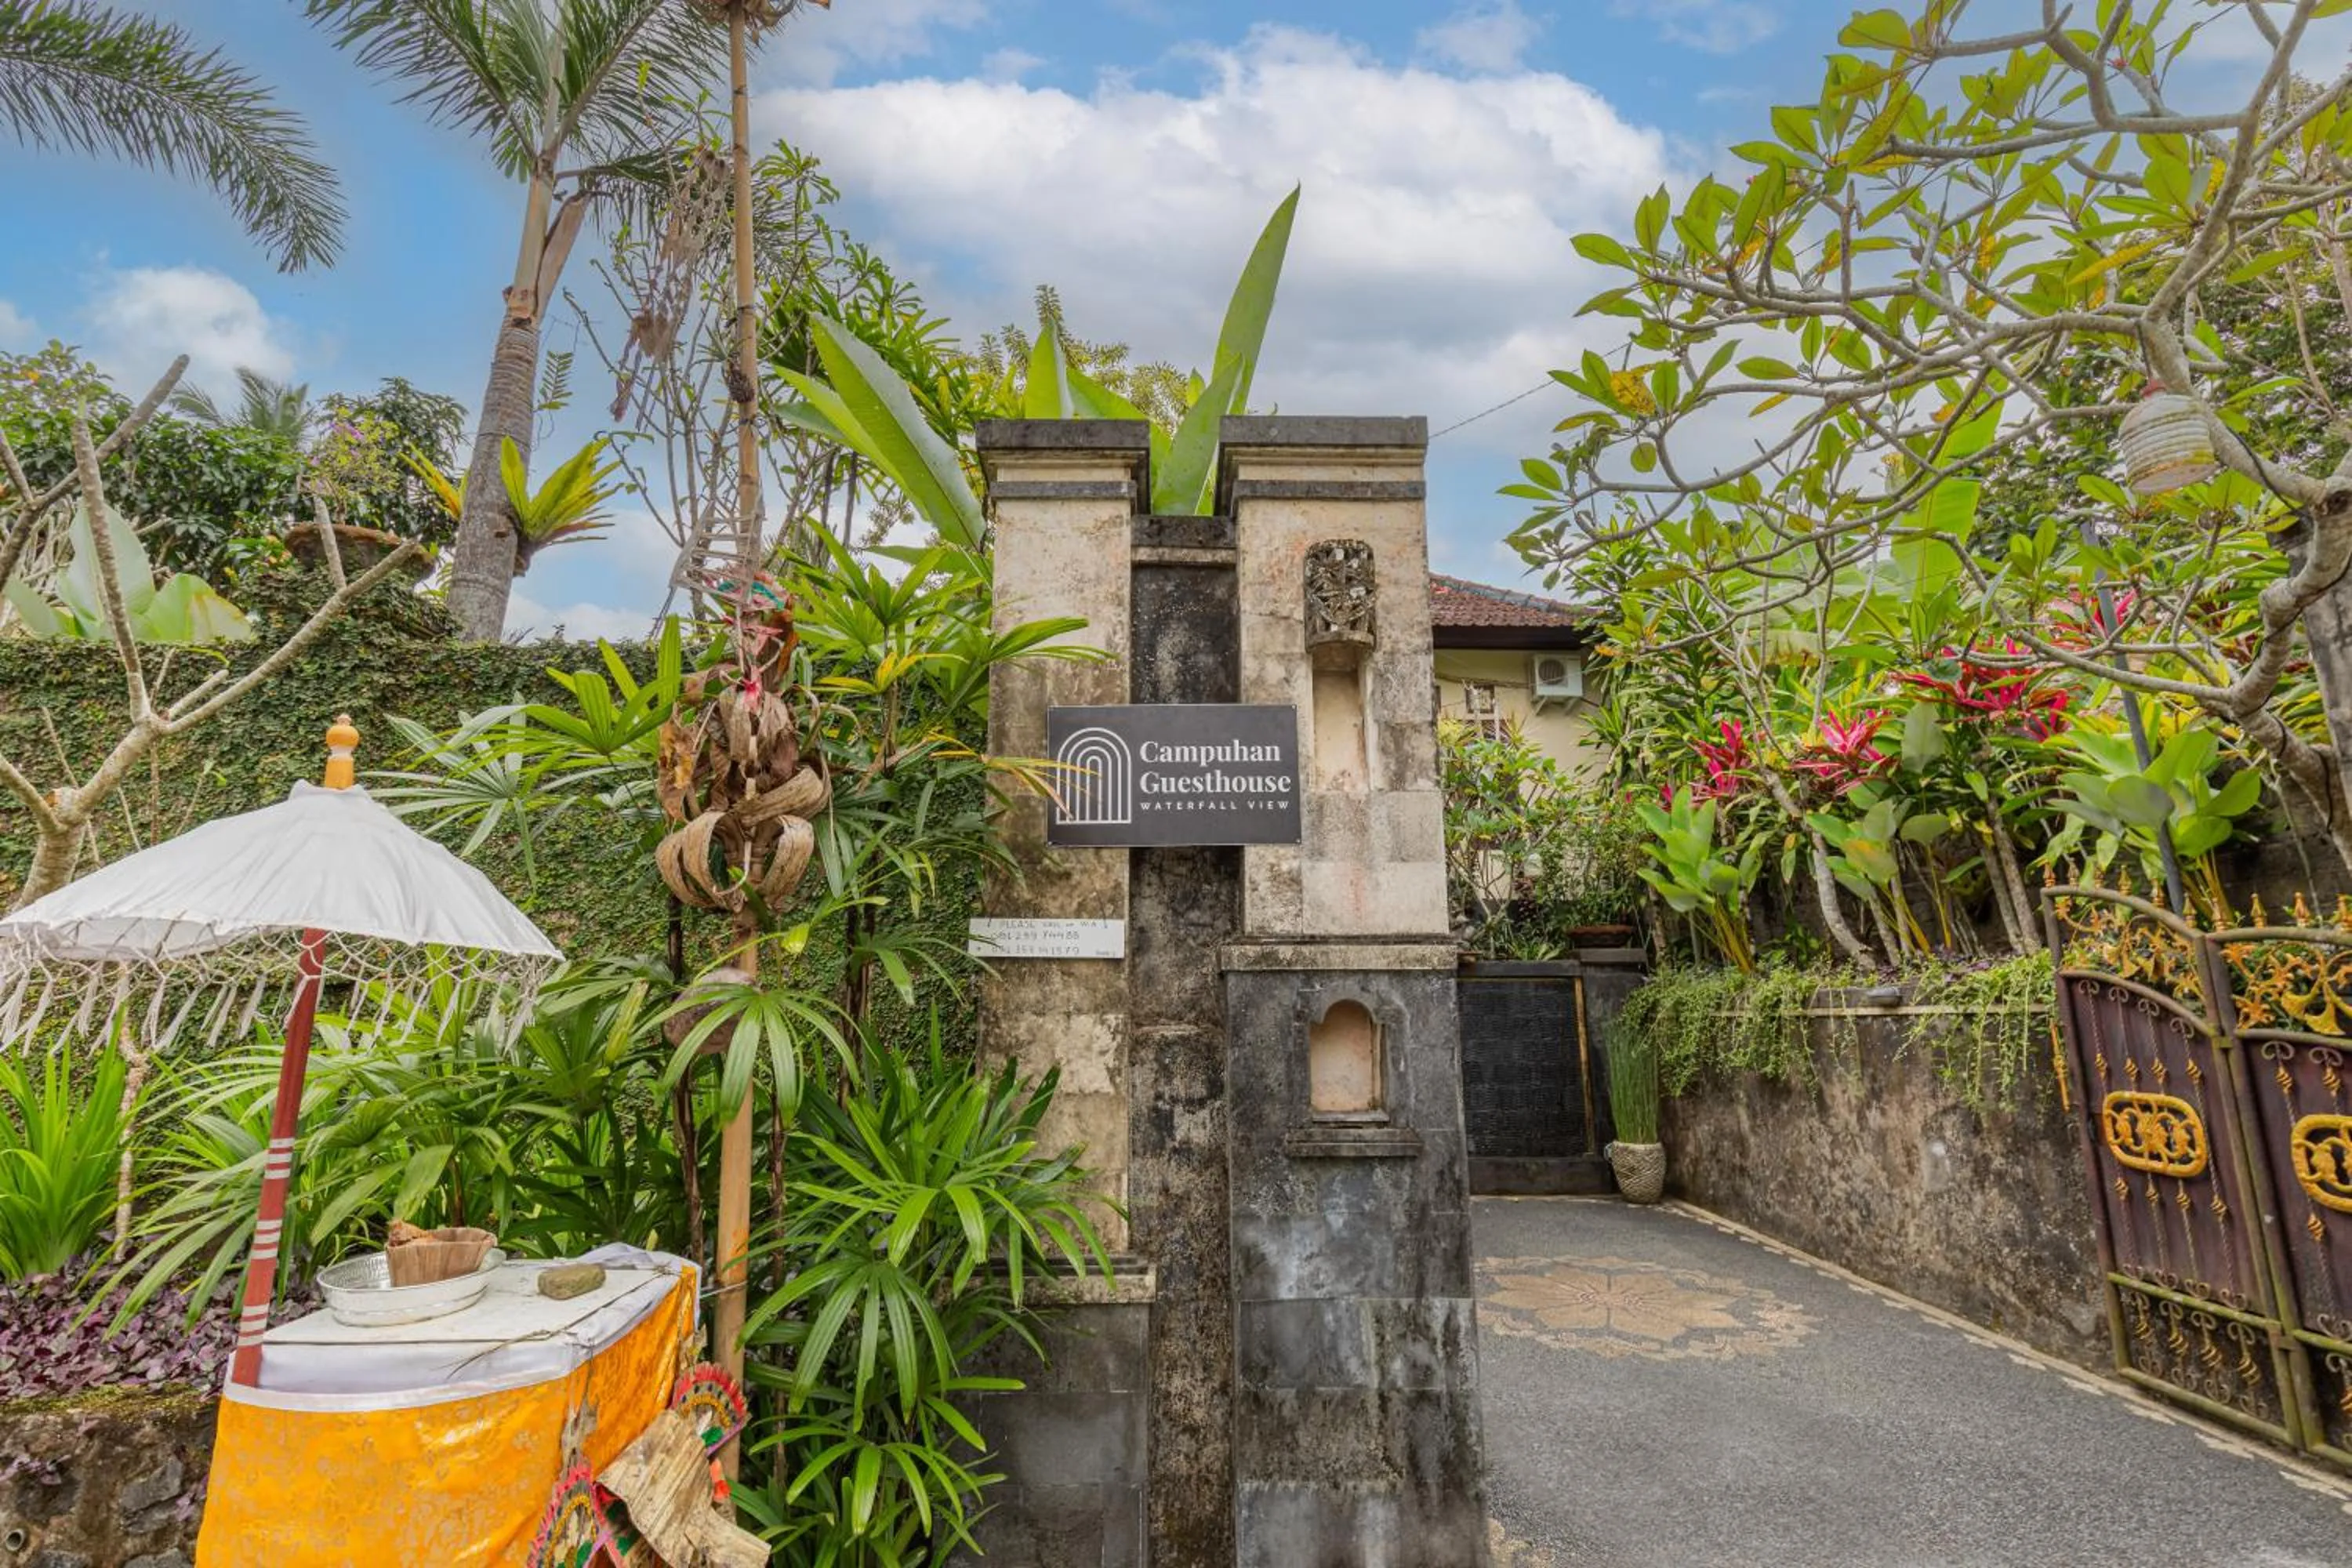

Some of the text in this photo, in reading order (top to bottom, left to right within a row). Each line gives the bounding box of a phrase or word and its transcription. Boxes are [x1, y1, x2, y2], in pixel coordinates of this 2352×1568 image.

[1140, 739, 1279, 767] Campuhan
[1140, 770, 1290, 793] Guesthouse
[1141, 801, 1236, 810] WATERFALL
